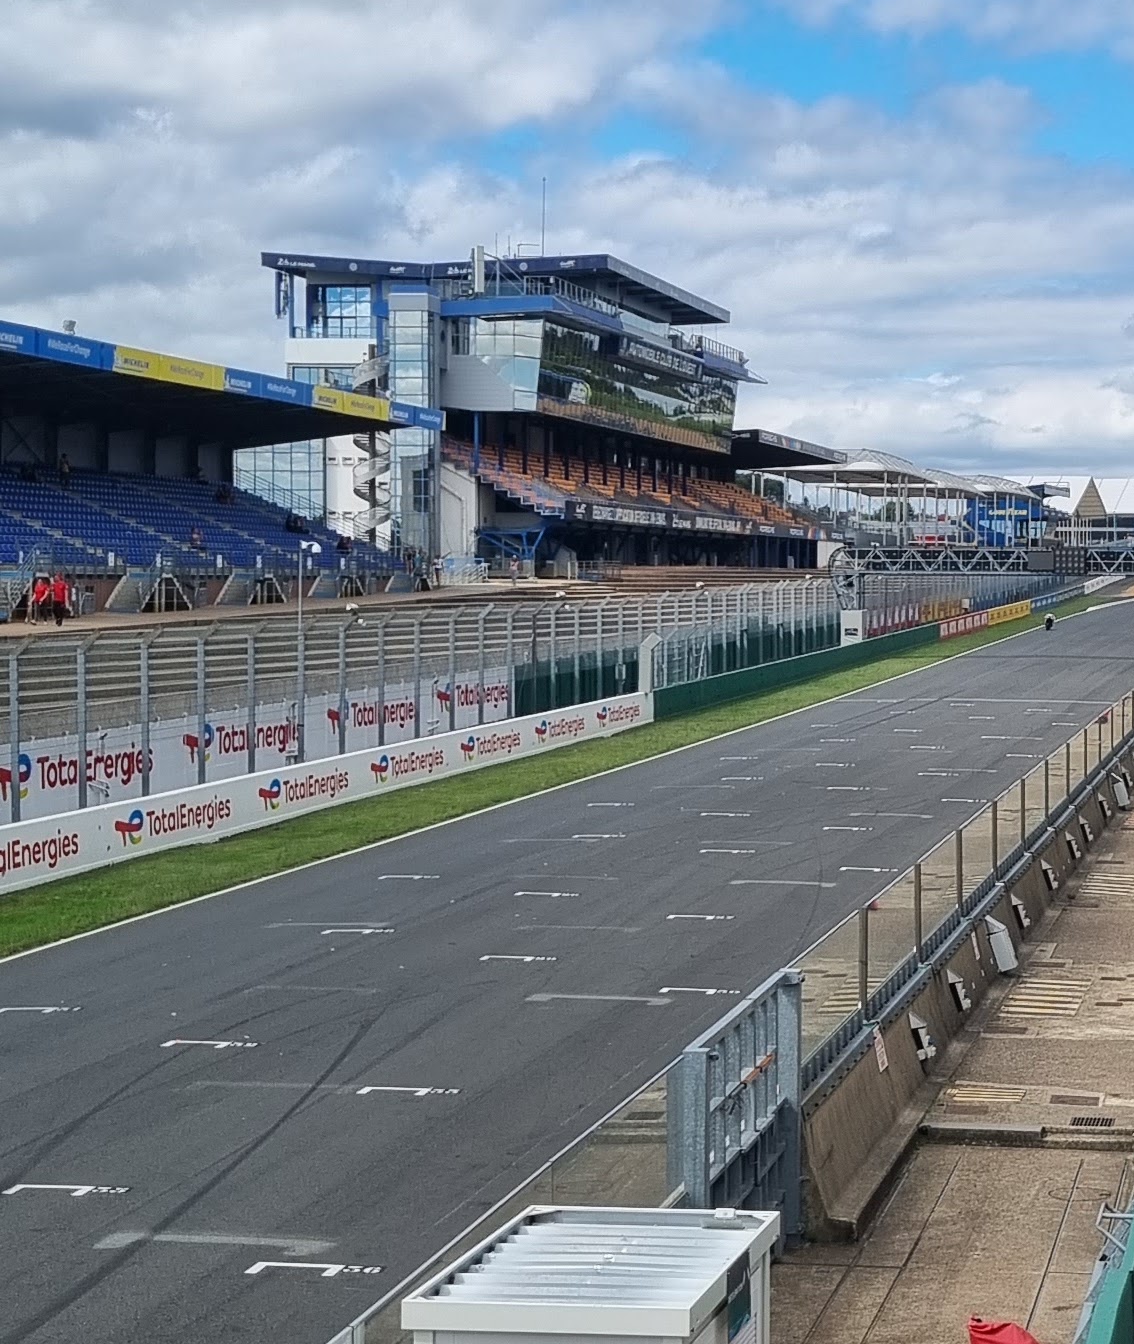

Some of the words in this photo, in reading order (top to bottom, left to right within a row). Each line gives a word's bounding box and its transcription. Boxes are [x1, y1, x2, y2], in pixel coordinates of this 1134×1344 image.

[476, 729, 520, 756] TotalEnergies
[548, 715, 585, 738] TotalEnergies
[390, 746, 443, 778] TotalEnergies
[283, 768, 349, 804] TotalEnergies
[147, 794, 231, 837] TotalEnergies
